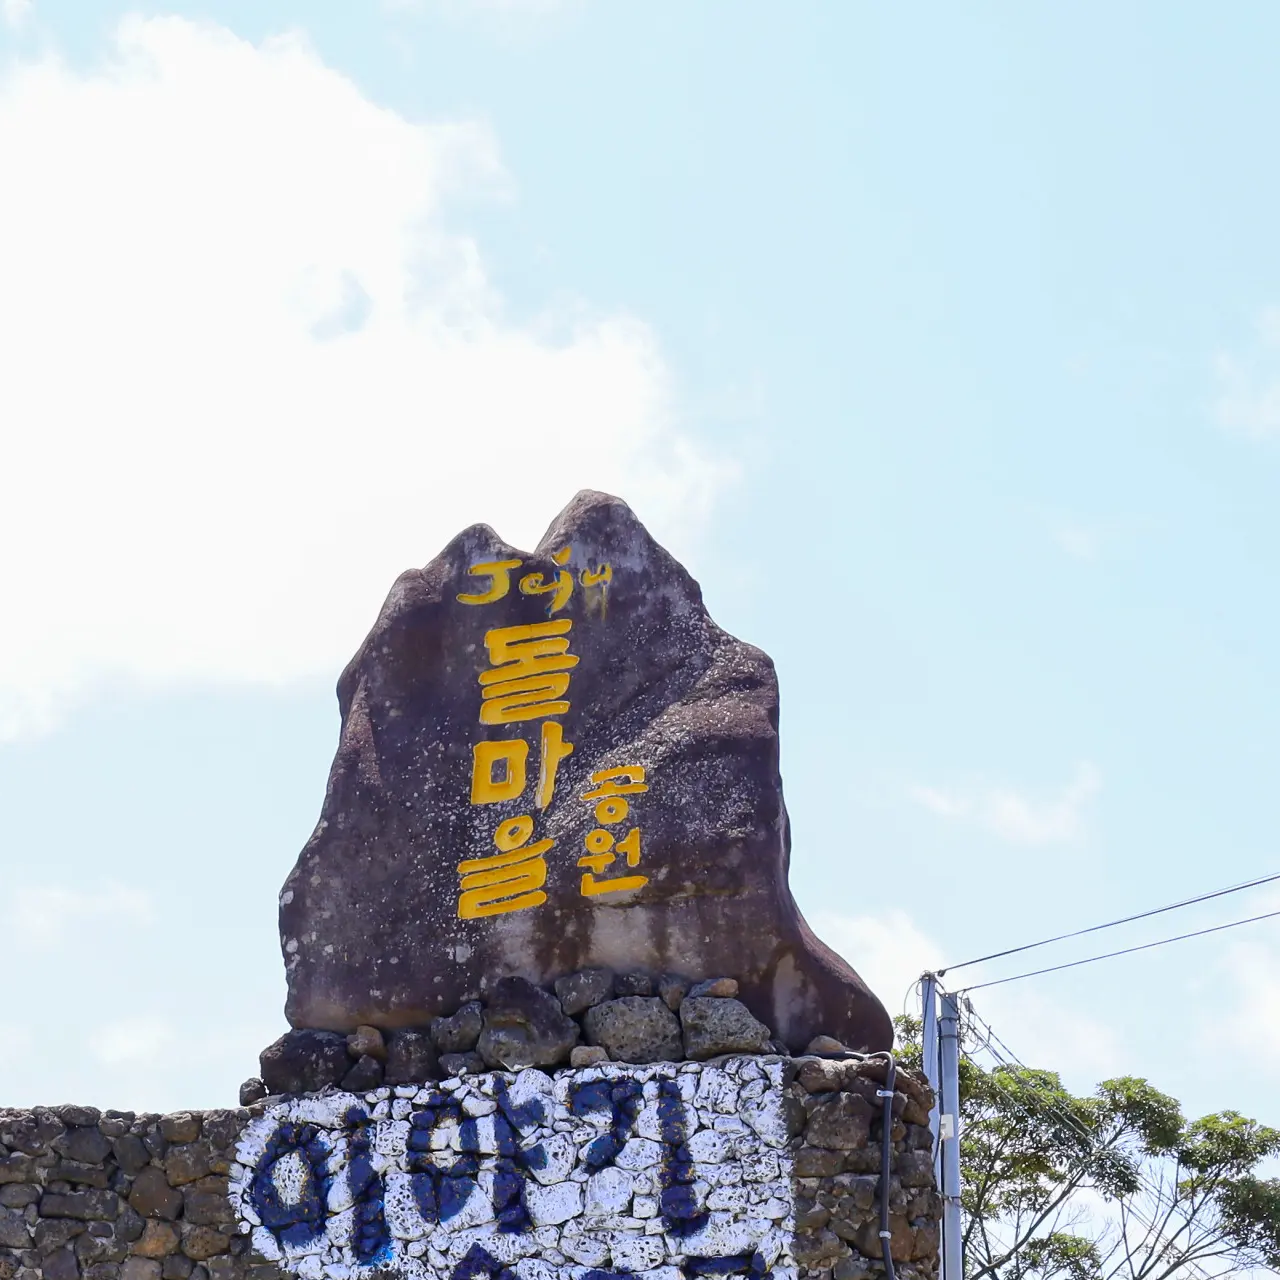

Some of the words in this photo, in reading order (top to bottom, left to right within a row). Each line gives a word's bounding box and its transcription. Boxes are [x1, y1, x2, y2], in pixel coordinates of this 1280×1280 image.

[456, 547, 612, 618] Jeju
[457, 618, 579, 920] 돌마을
[578, 765, 649, 898] 공원
[249, 1076, 710, 1265] 이야기
